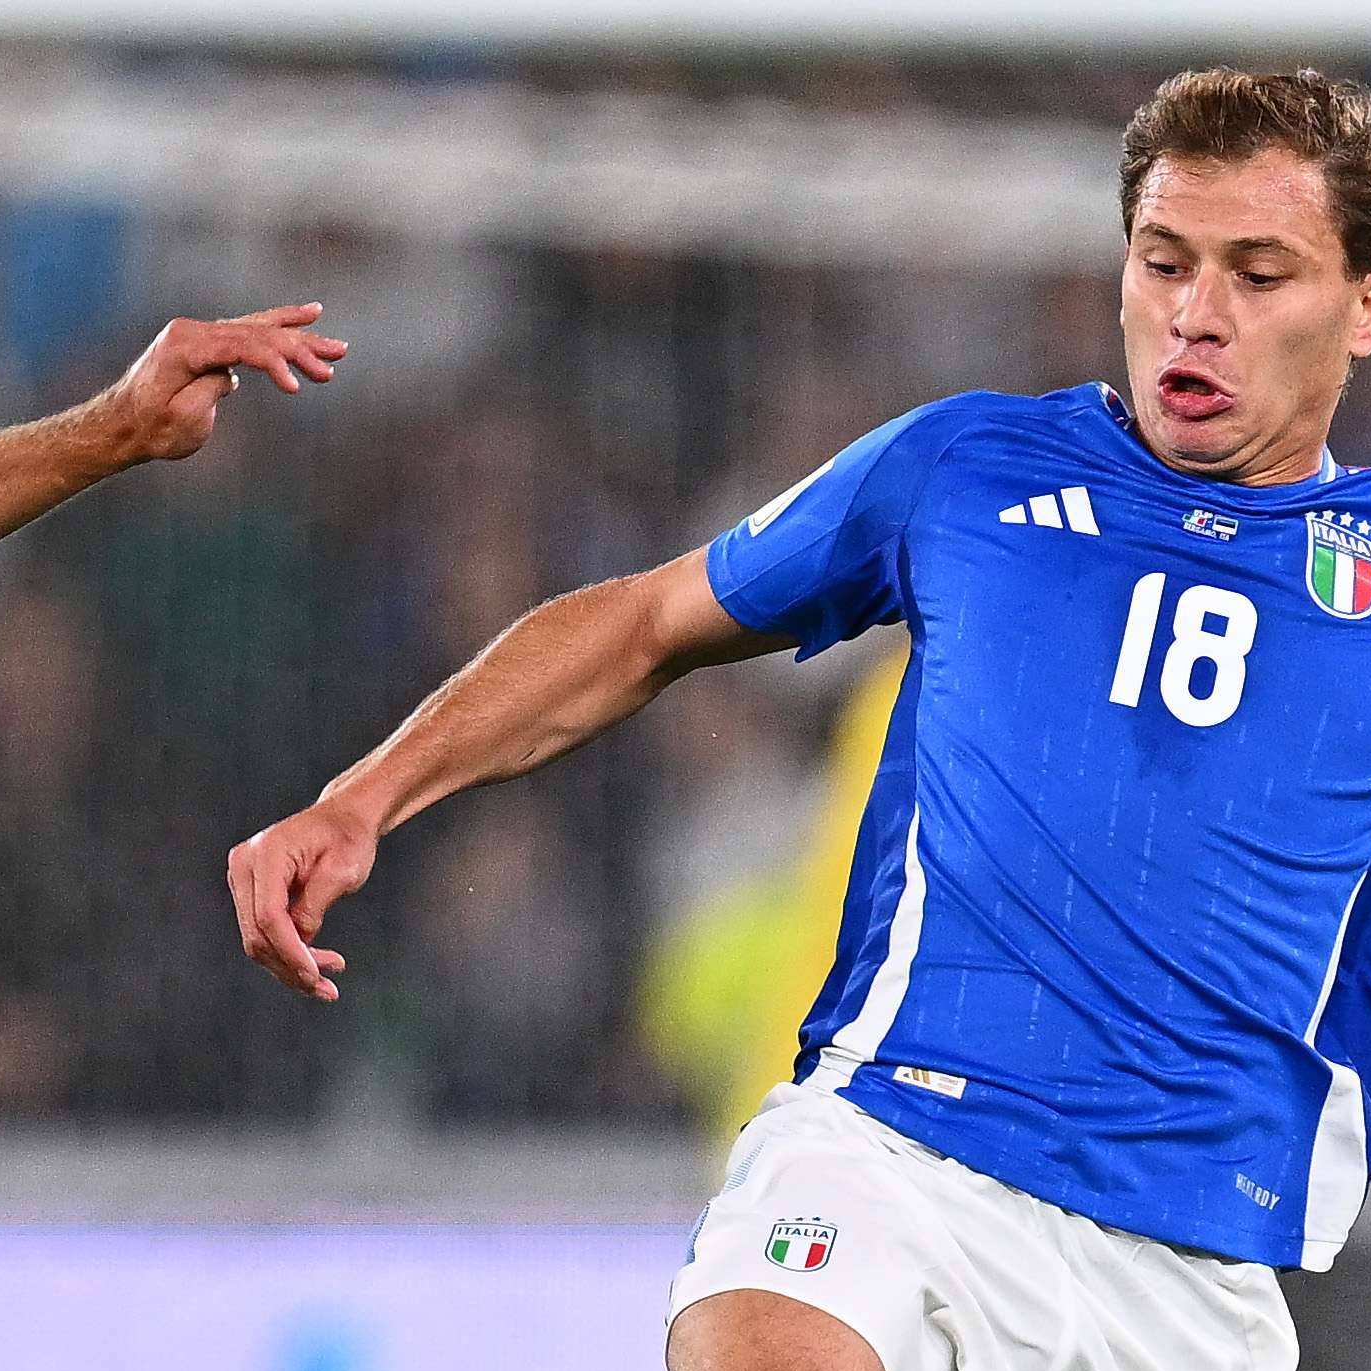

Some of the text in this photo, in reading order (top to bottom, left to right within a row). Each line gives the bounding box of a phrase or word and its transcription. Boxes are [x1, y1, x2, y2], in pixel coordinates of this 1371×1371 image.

[1313, 521, 1371, 558] ITALIA
[1109, 572, 1258, 727] 18
[777, 1226, 829, 1240] ITALIA
